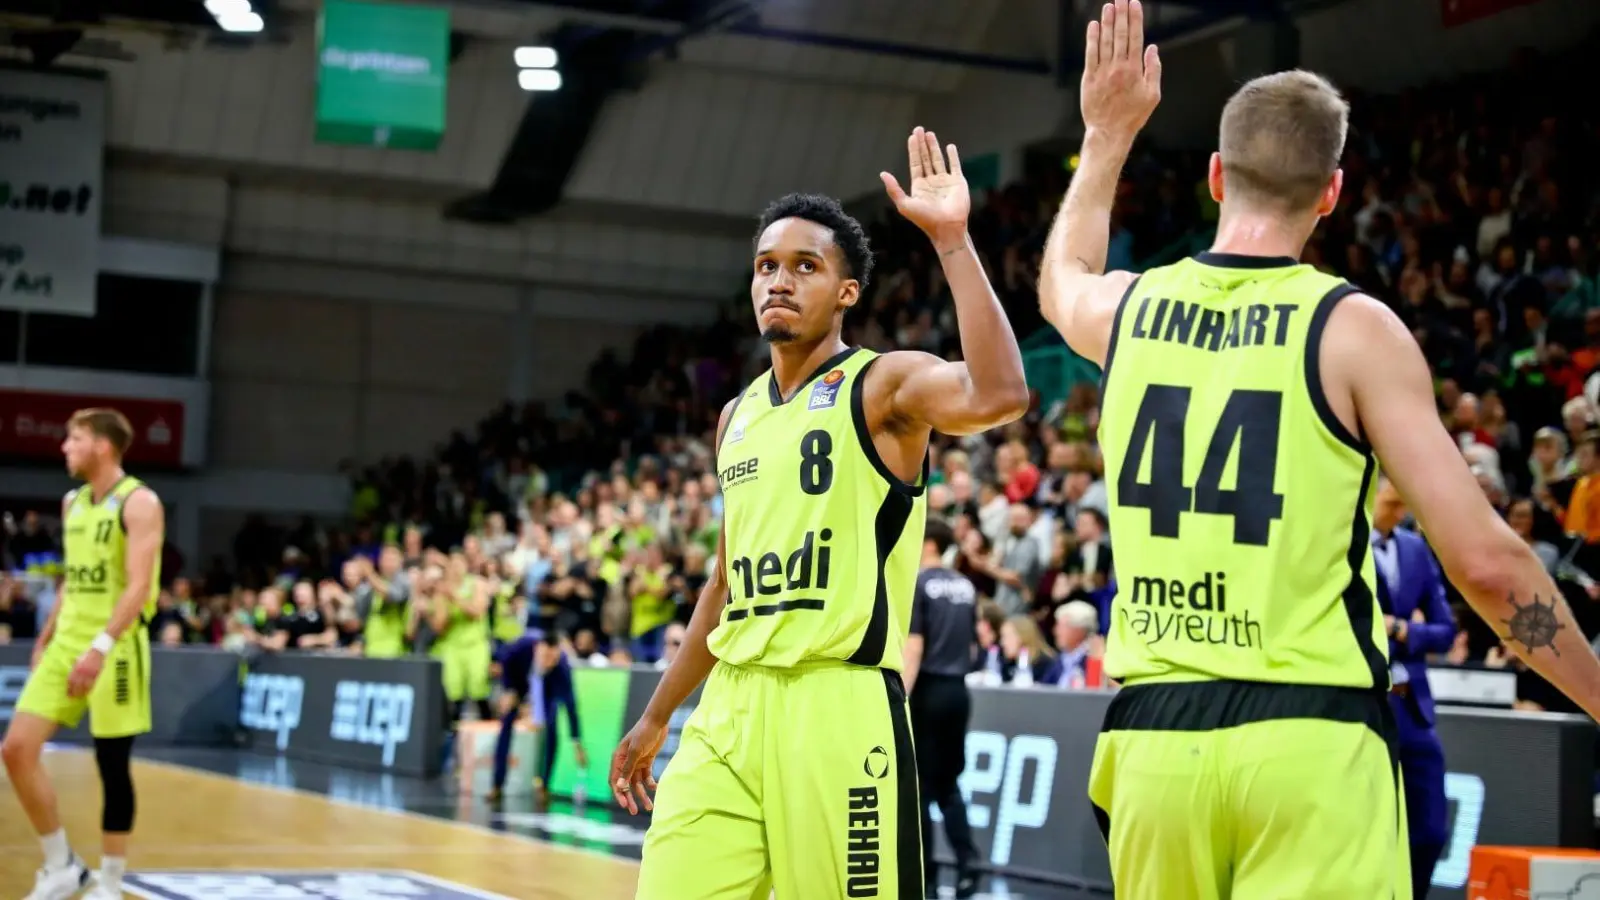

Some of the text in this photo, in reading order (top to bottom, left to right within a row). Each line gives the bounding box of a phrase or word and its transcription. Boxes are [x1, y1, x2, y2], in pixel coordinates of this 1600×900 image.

[1131, 297, 1299, 352] LINHART
[799, 429, 833, 496] 8
[1118, 384, 1284, 547] 44
[1131, 571, 1226, 612] medi
[847, 786, 880, 898] REHAU
[957, 731, 1058, 866] ep
